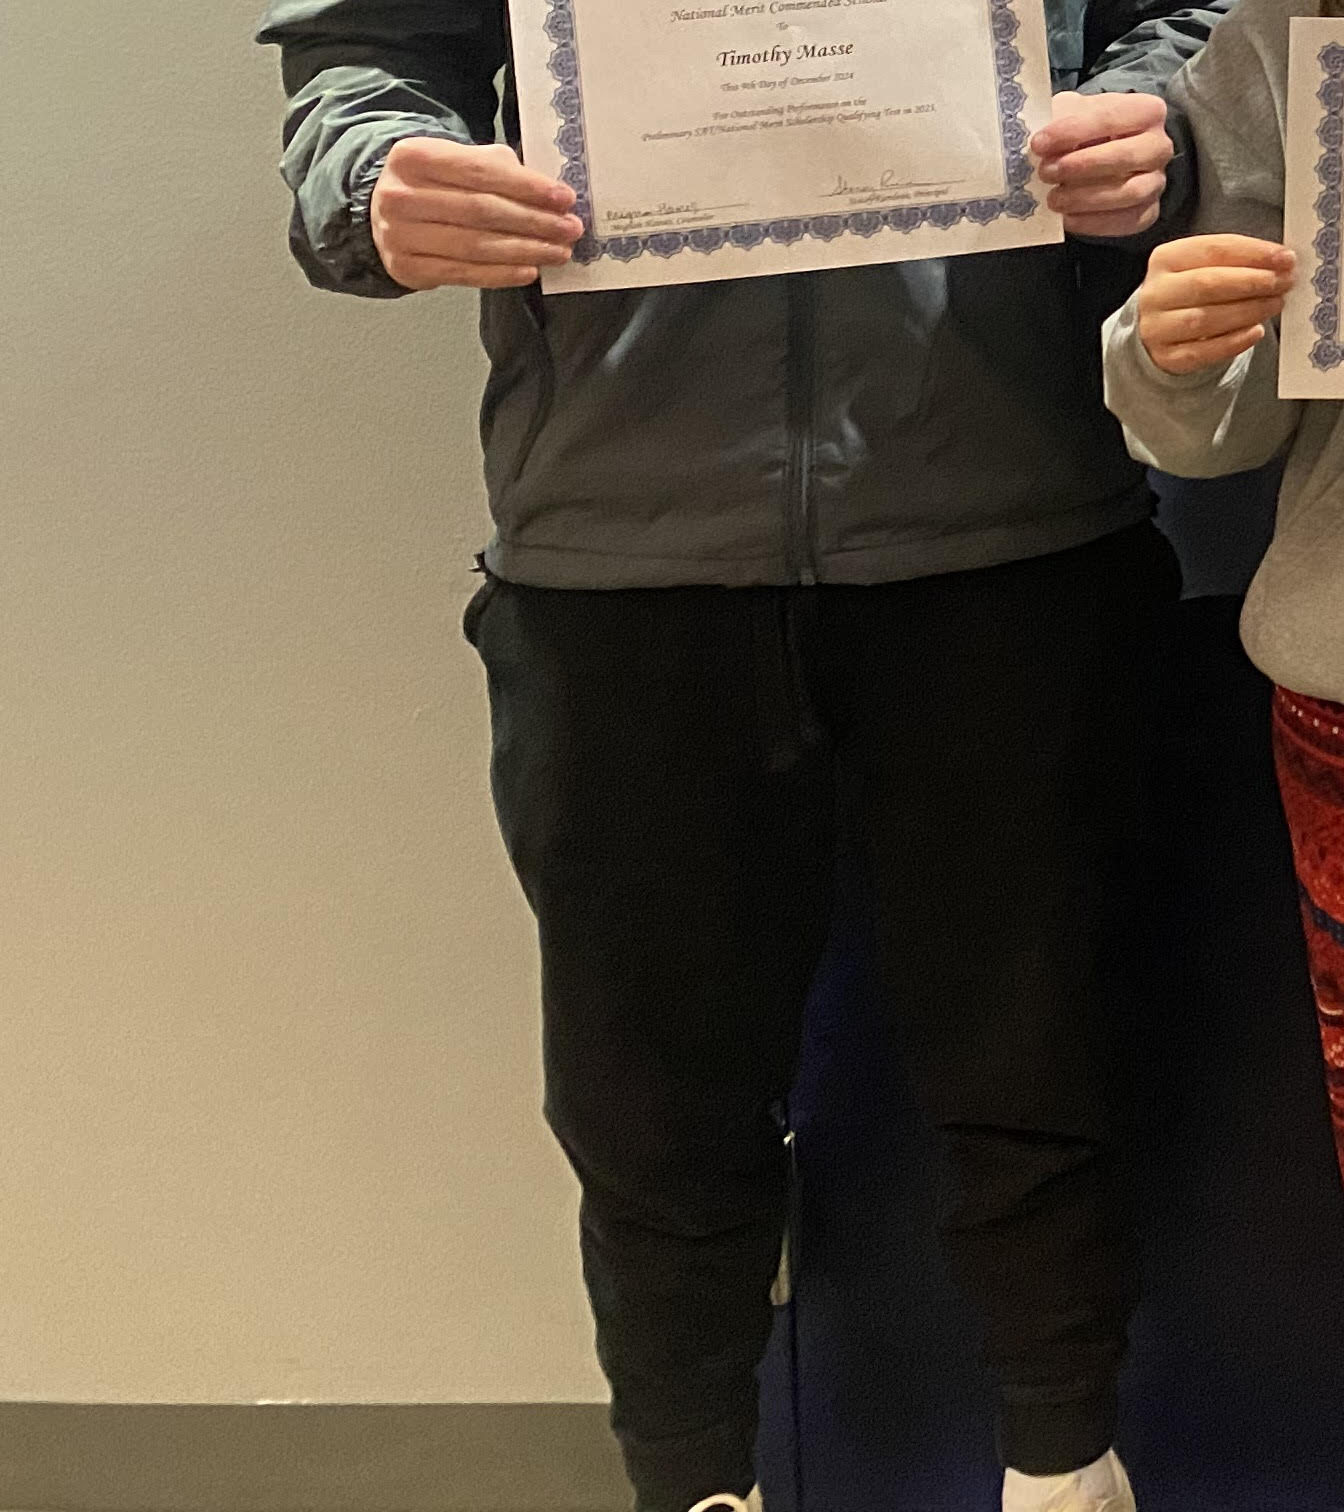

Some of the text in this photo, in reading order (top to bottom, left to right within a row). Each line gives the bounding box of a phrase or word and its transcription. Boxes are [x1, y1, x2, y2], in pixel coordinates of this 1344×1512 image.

[671, 5, 728, 22] National
[730, 3, 765, 17] Merit
[716, 42, 854, 67] Timothy Masse
